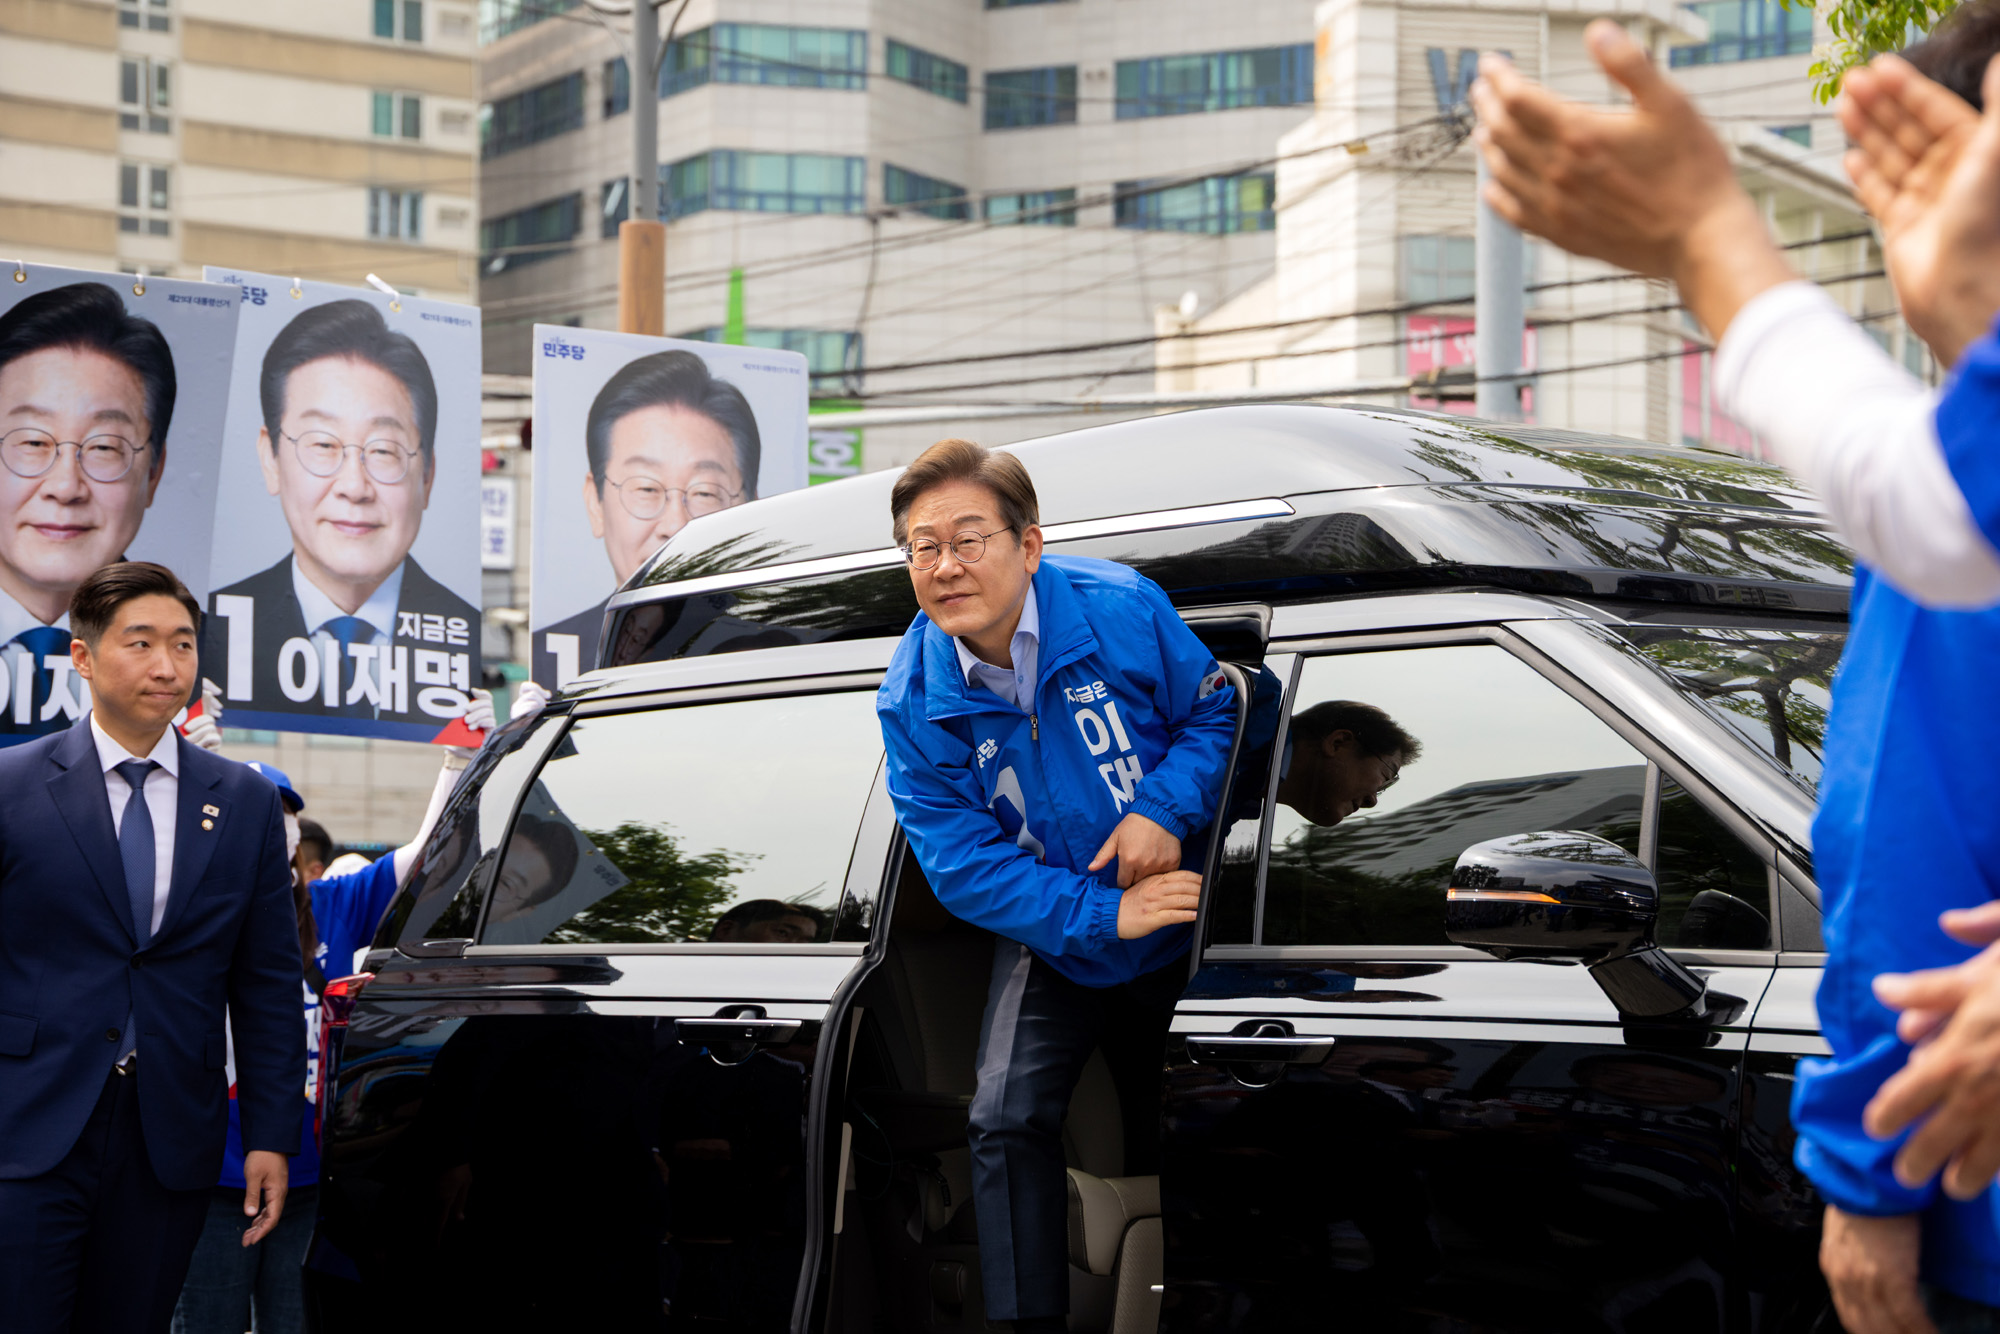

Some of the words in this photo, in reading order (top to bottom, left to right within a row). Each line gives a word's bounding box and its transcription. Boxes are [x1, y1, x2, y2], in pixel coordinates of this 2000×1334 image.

[543, 343, 585, 360] 민주당
[216, 594, 254, 701] 1
[397, 611, 469, 646] 지금은
[278, 637, 471, 719] 이재명
[546, 633, 580, 691] 1
[1063, 681, 1108, 704] 지금은
